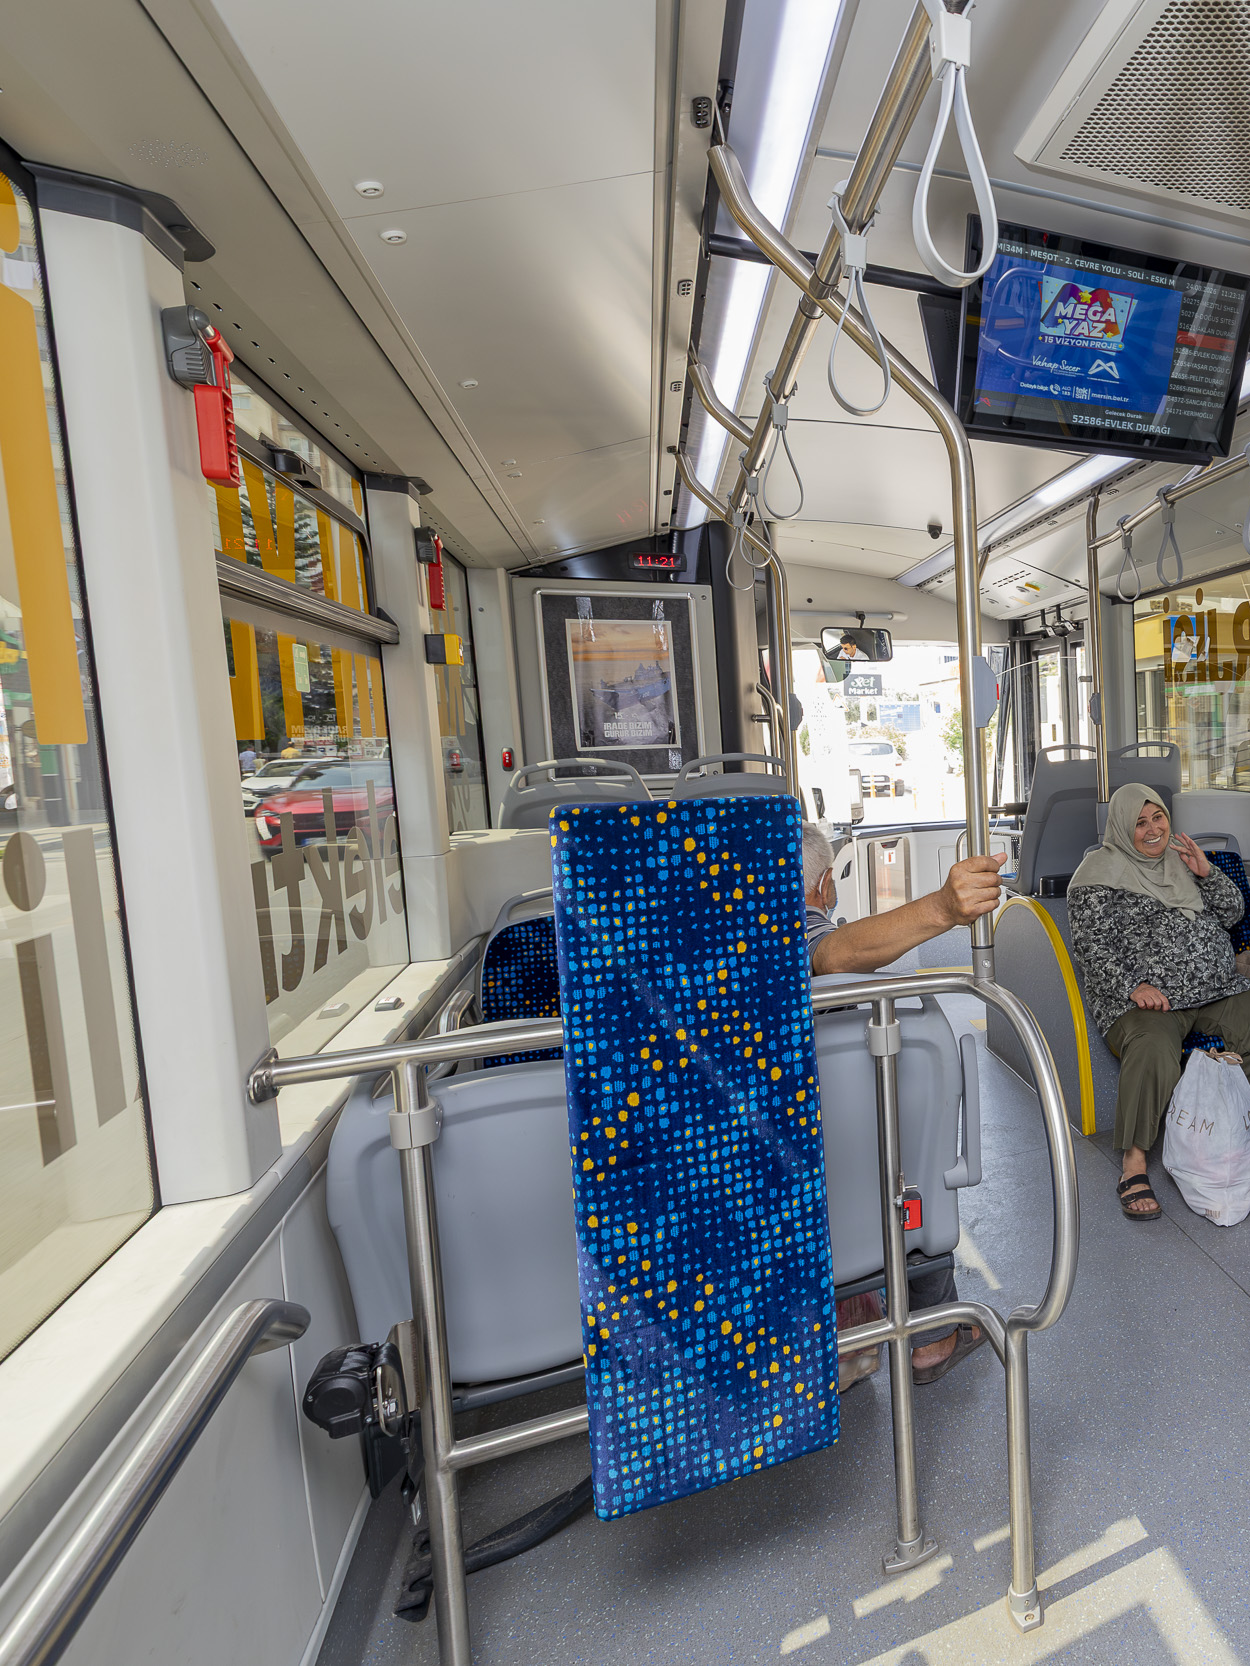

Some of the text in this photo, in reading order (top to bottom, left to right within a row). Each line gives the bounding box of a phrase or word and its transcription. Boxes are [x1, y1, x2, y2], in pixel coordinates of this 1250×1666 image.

[1030, 250, 1058, 263] MEŞOT
[1065, 257, 1073, 265] 2.
[1074, 258, 1100, 272] ÇEVRE
[1101, 264, 1121, 275] YOLU
[1127, 269, 1145, 280] SOLİ
[1150, 274, 1167, 286] ESKİ
[1054, 301, 1116, 323] MEGA
[1063, 319, 1106, 338] YAZ
[1044, 335, 1054, 344] 15
[1090, 341, 1118, 350] PROJE
[1032, 354, 1058, 373] Vahap
[1091, 392, 1129, 403] mersin.bel.tr
[1104, 409, 1143, 419] Gelecek Durak
[1072, 414, 1171, 435] 52586-EVLEK DURAĞI
[638, 556, 675, 568] 11:21
[848, 687, 878, 695] Market
